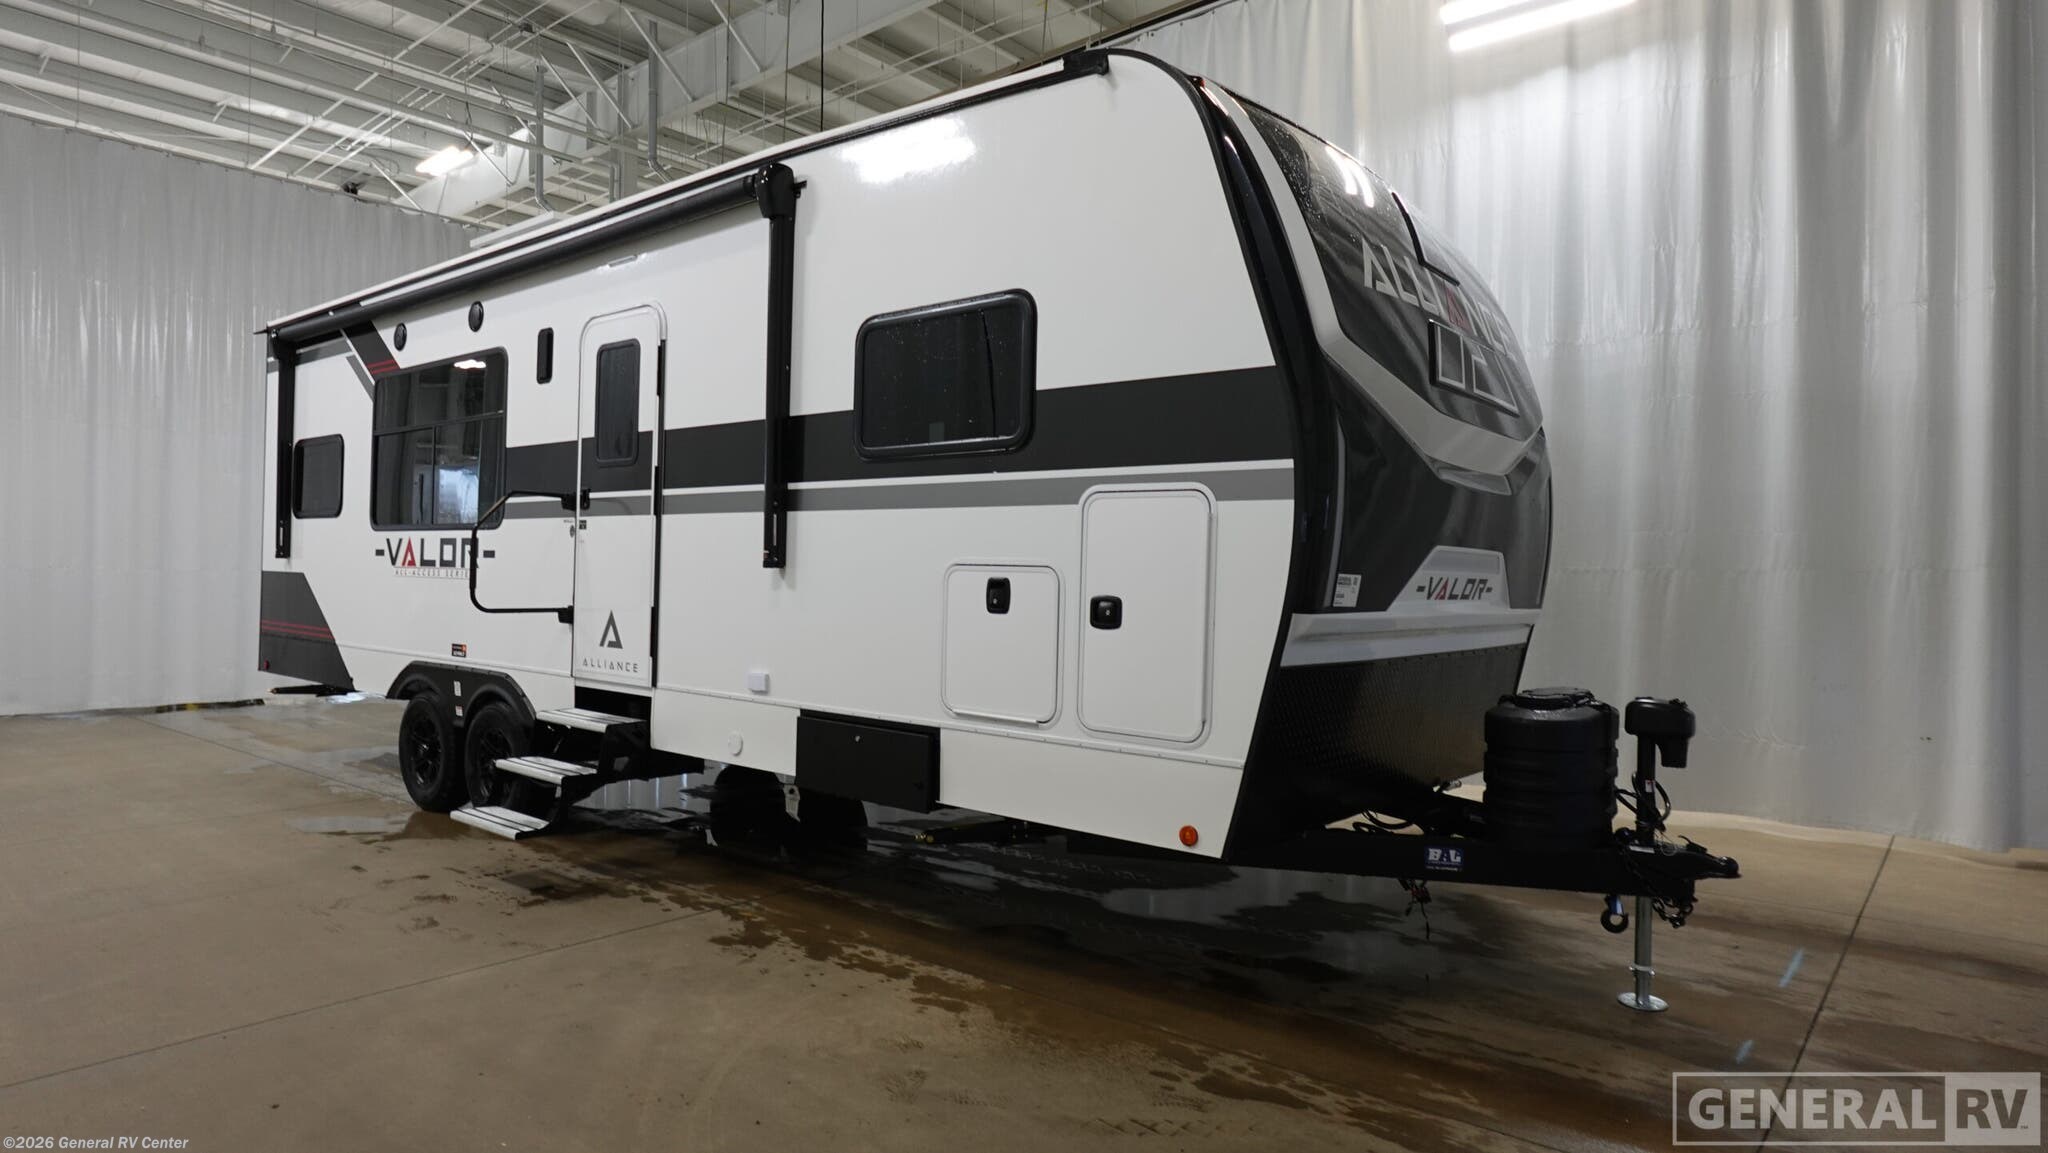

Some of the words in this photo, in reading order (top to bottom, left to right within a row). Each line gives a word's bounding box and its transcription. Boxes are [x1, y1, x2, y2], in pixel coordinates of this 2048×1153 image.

[1362, 238, 1518, 362] ALLIANCE
[445, 569, 470, 579] SERIE
[582, 657, 639, 673] ALLIANCE
